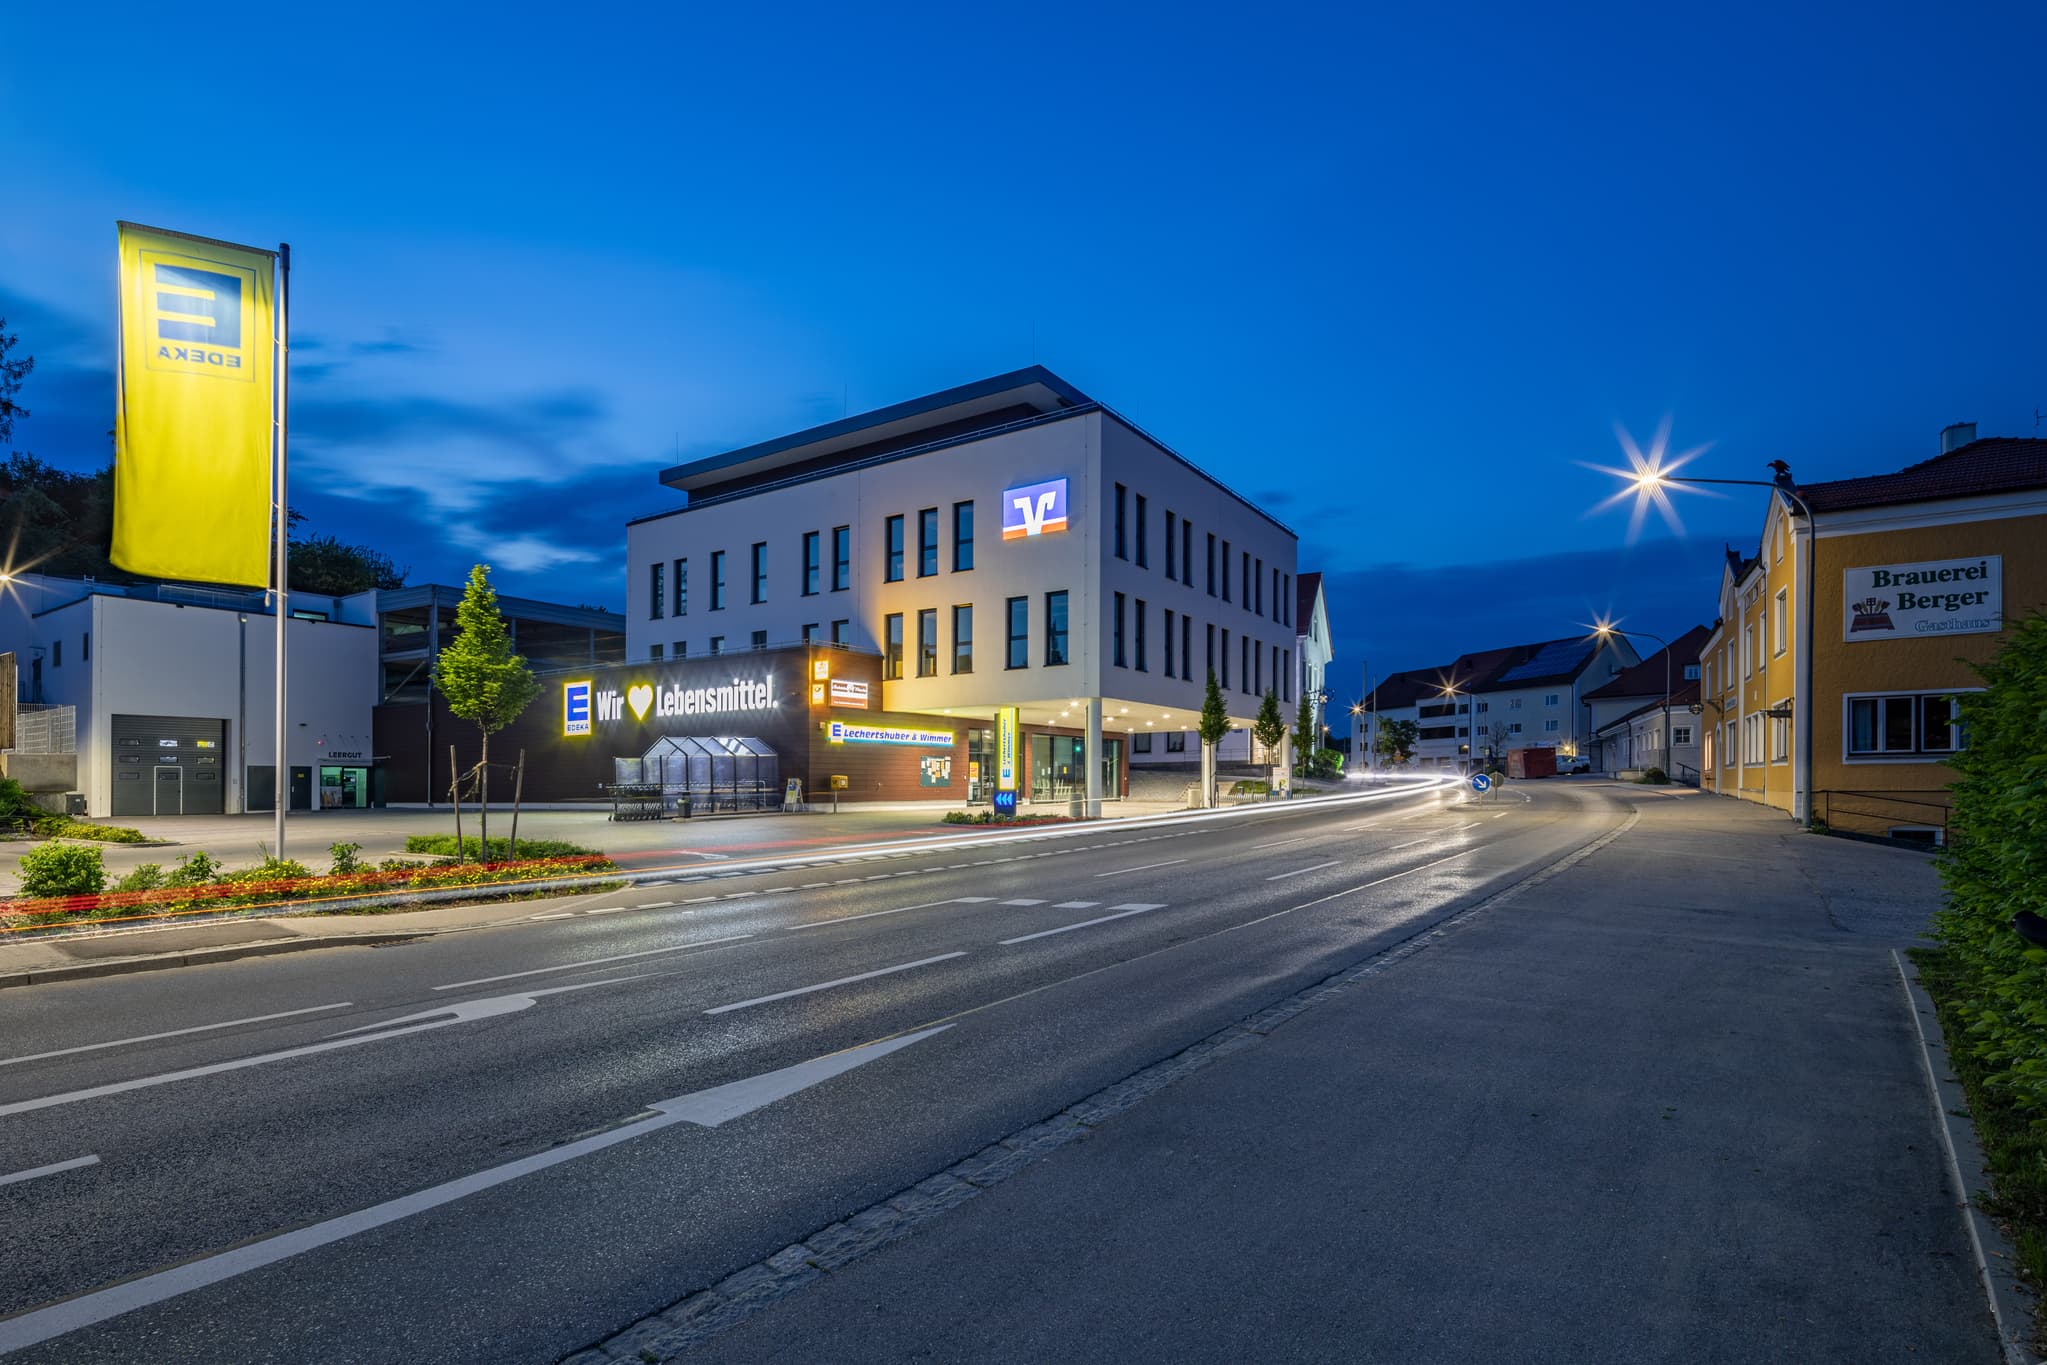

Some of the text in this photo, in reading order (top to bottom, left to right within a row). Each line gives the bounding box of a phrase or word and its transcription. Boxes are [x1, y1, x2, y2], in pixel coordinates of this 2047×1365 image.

[1872, 561, 1988, 588] Brauerei
[1896, 590, 1989, 612] Berger
[1914, 617, 1991, 633] Gasthaus
[597, 674, 779, 721] Wir Lebensmittel.
[844, 729, 952, 743] Lechertshuber & Wimmer
